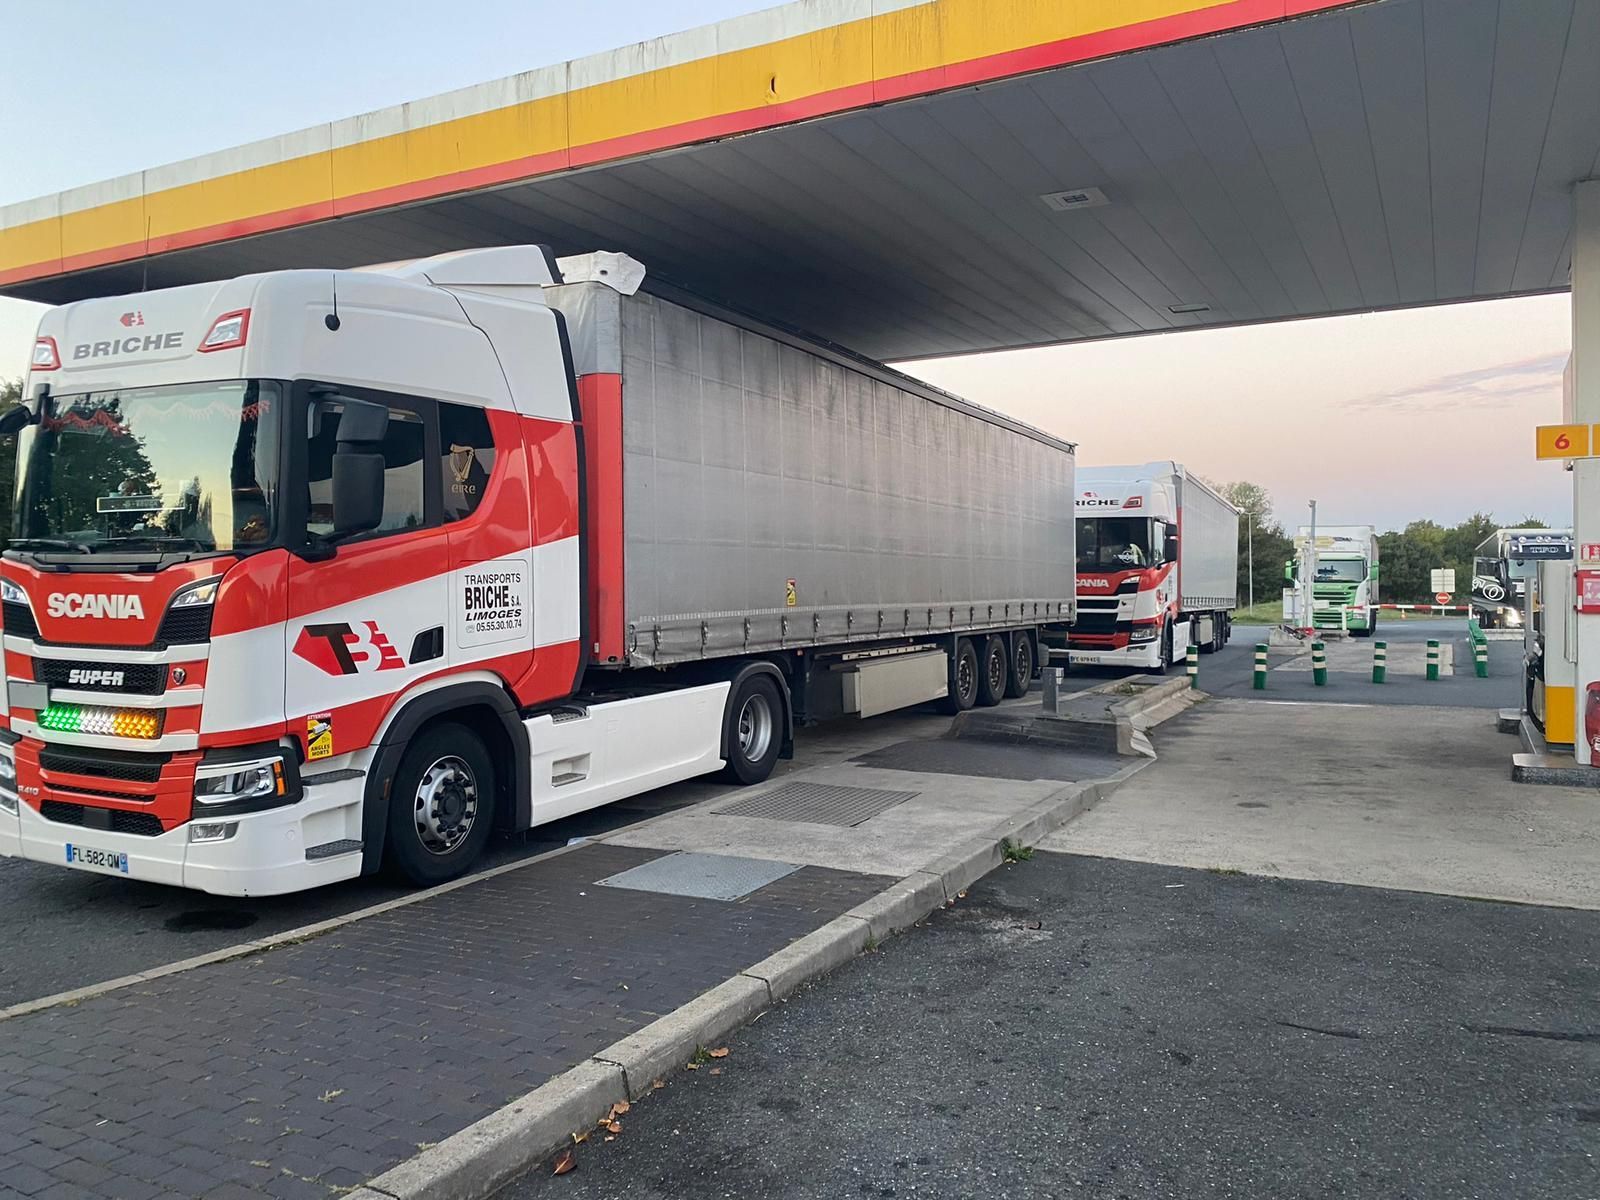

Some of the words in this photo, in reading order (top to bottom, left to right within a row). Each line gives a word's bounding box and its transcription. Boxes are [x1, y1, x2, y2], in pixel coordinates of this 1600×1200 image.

[73, 332, 184, 360] BRICHE
[1554, 433, 1570, 450] 6
[464, 573, 521, 585] TRANSPORTS
[1076, 579, 1109, 588] CANIA
[47, 592, 145, 620] SCANIA
[465, 585, 509, 610] BRICHE
[465, 609, 522, 622] LIMOGES
[476, 619, 522, 632] 05.55.30.10.74
[68, 669, 125, 686] SUPER
